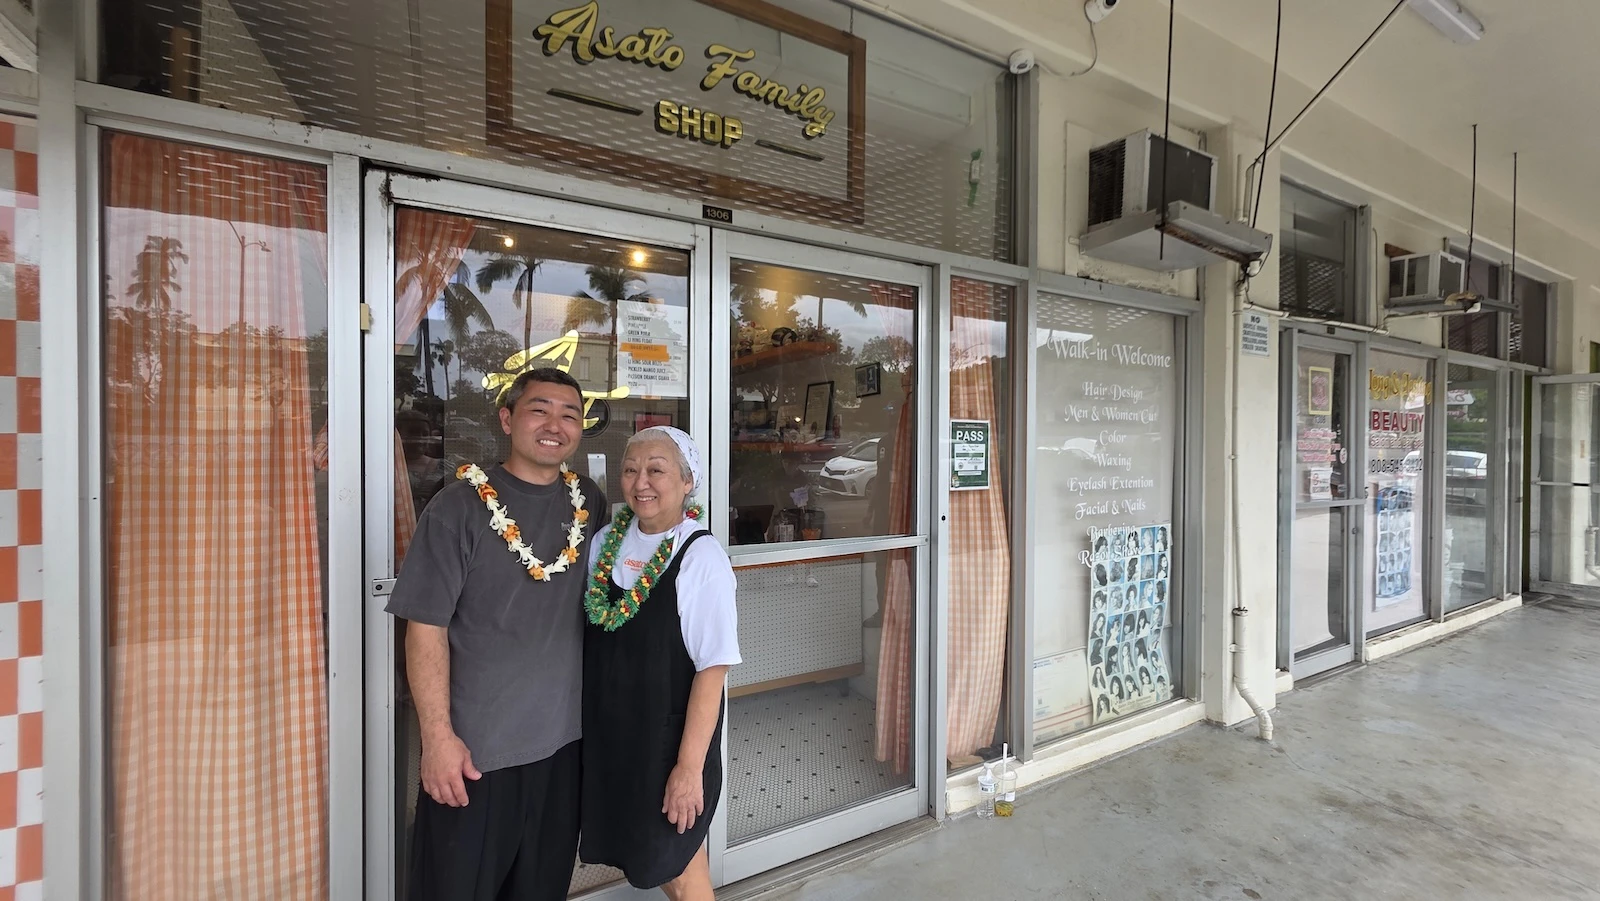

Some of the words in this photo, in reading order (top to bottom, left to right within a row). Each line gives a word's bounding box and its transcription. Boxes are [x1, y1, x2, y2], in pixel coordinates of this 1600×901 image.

[532, 0, 685, 72] Asato
[699, 43, 836, 140] Family
[654, 99, 743, 149] SHOP
[706, 208, 729, 220] 1306
[1250, 315, 1261, 323] NO
[1046, 336, 1108, 361] Walk-in
[1111, 343, 1172, 368] Welcome
[1082, 381, 1107, 397] Hair
[1109, 383, 1143, 404] Design
[1064, 404, 1088, 423] Men
[1090, 405, 1100, 422] &
[1101, 406, 1138, 422] Women
[1139, 408, 1158, 424] Cut
[1371, 410, 1424, 433] BEAUTY
[956, 430, 985, 442] PASS
[1099, 429, 1127, 446] Color
[1094, 453, 1132, 471] Waxing
[1066, 476, 1107, 497] Eyelash
[1109, 475, 1154, 491] Extention
[1074, 500, 1109, 520] Facial
[1111, 500, 1120, 515] &
[1121, 498, 1146, 515] Nails
